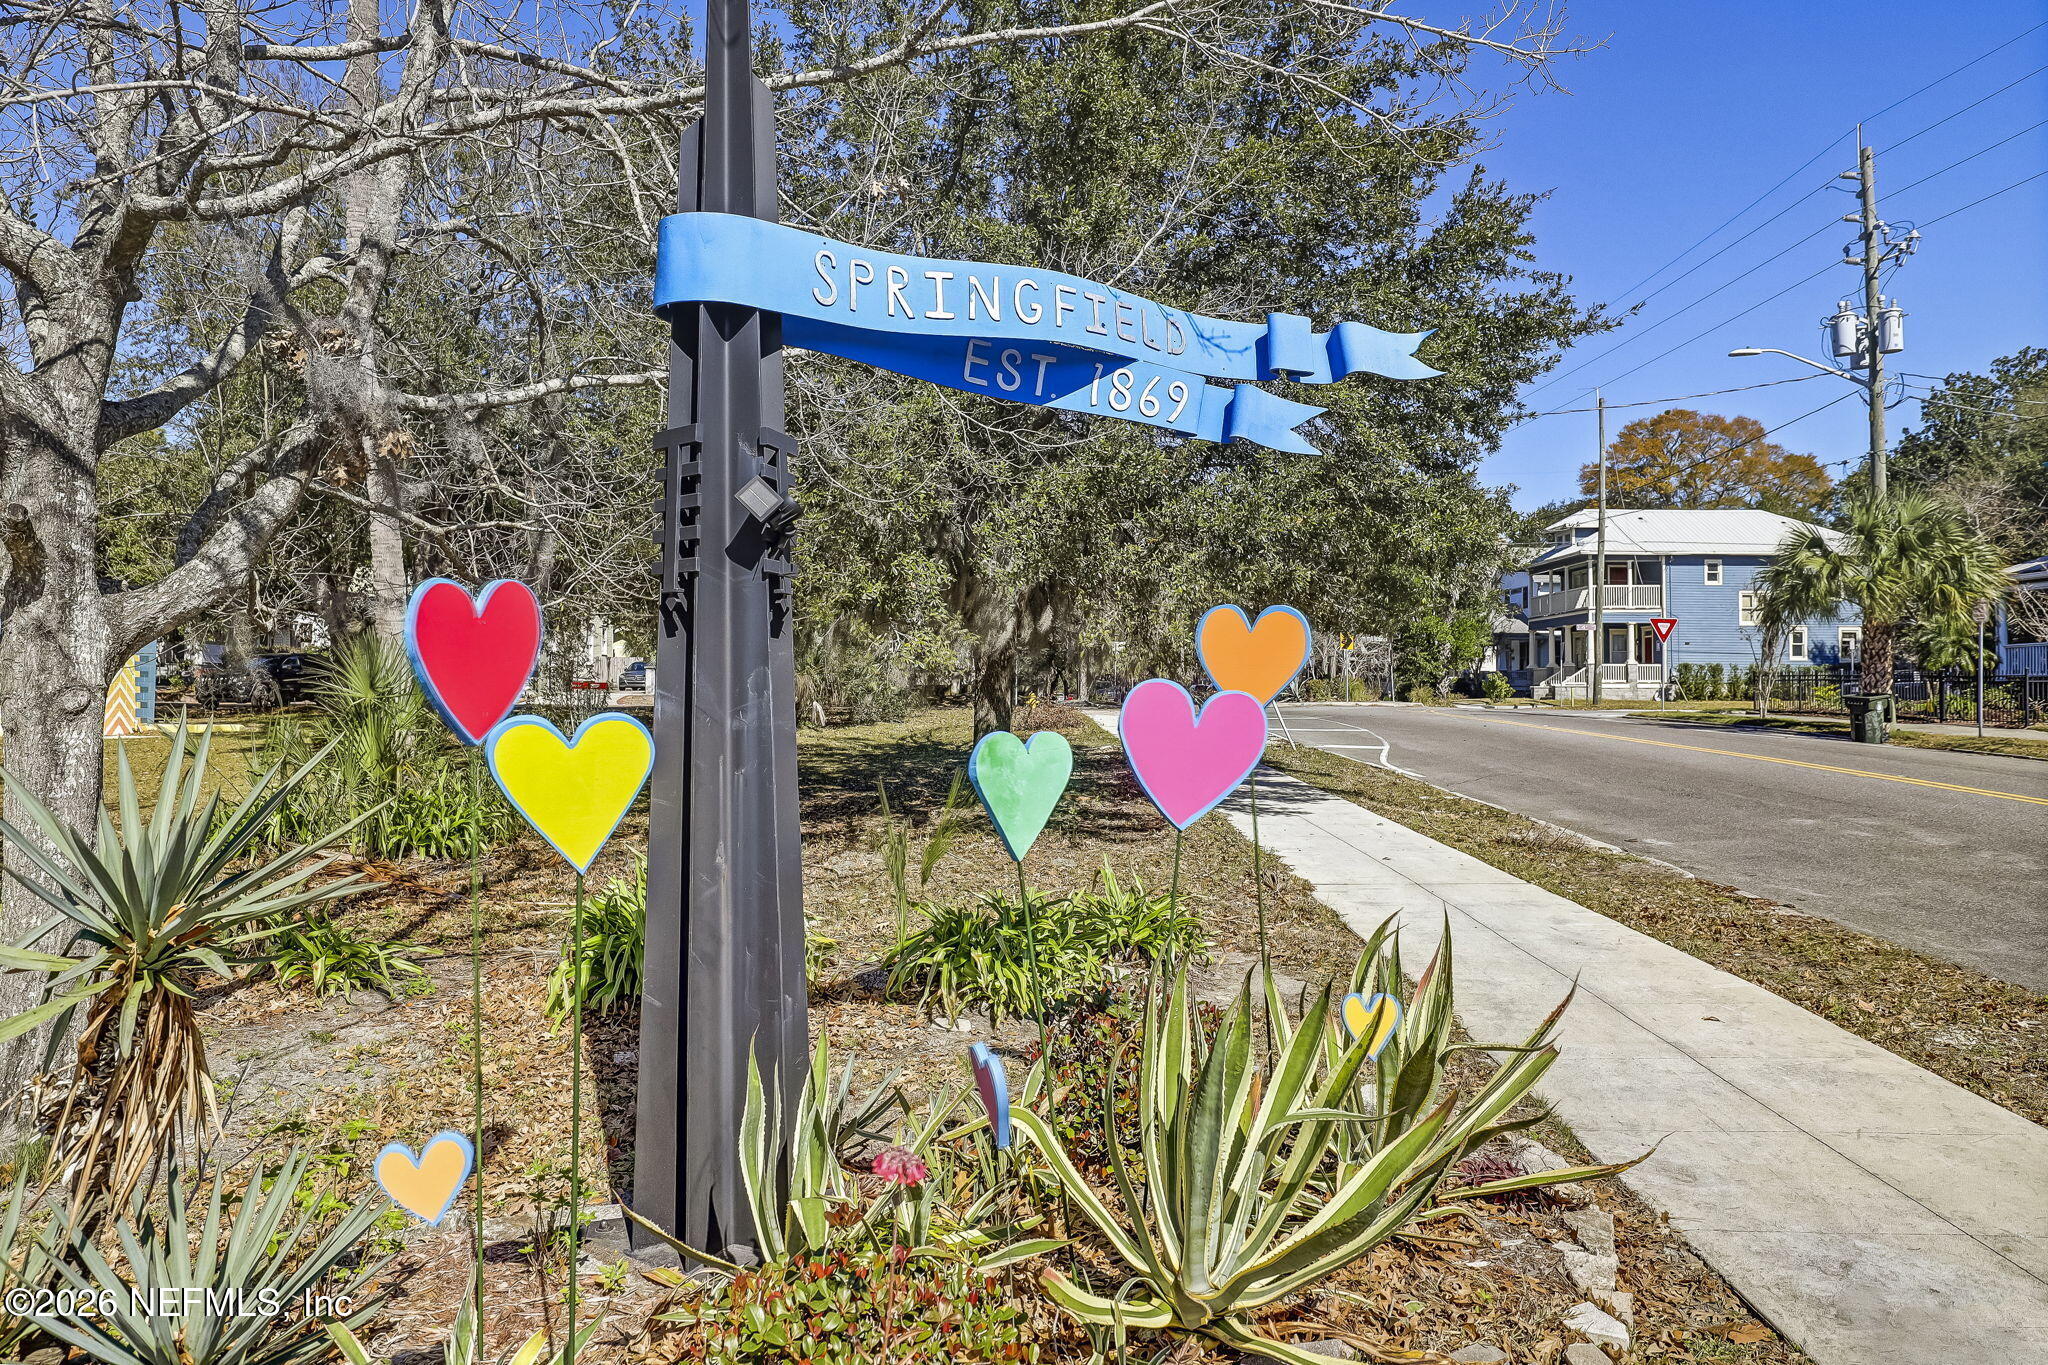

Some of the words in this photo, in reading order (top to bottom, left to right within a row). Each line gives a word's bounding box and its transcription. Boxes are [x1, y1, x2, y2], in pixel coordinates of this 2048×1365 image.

[812, 249, 1187, 356] SPRINGFIELD
[963, 338, 1057, 399] EST.
[1090, 362, 1189, 424] 1869
